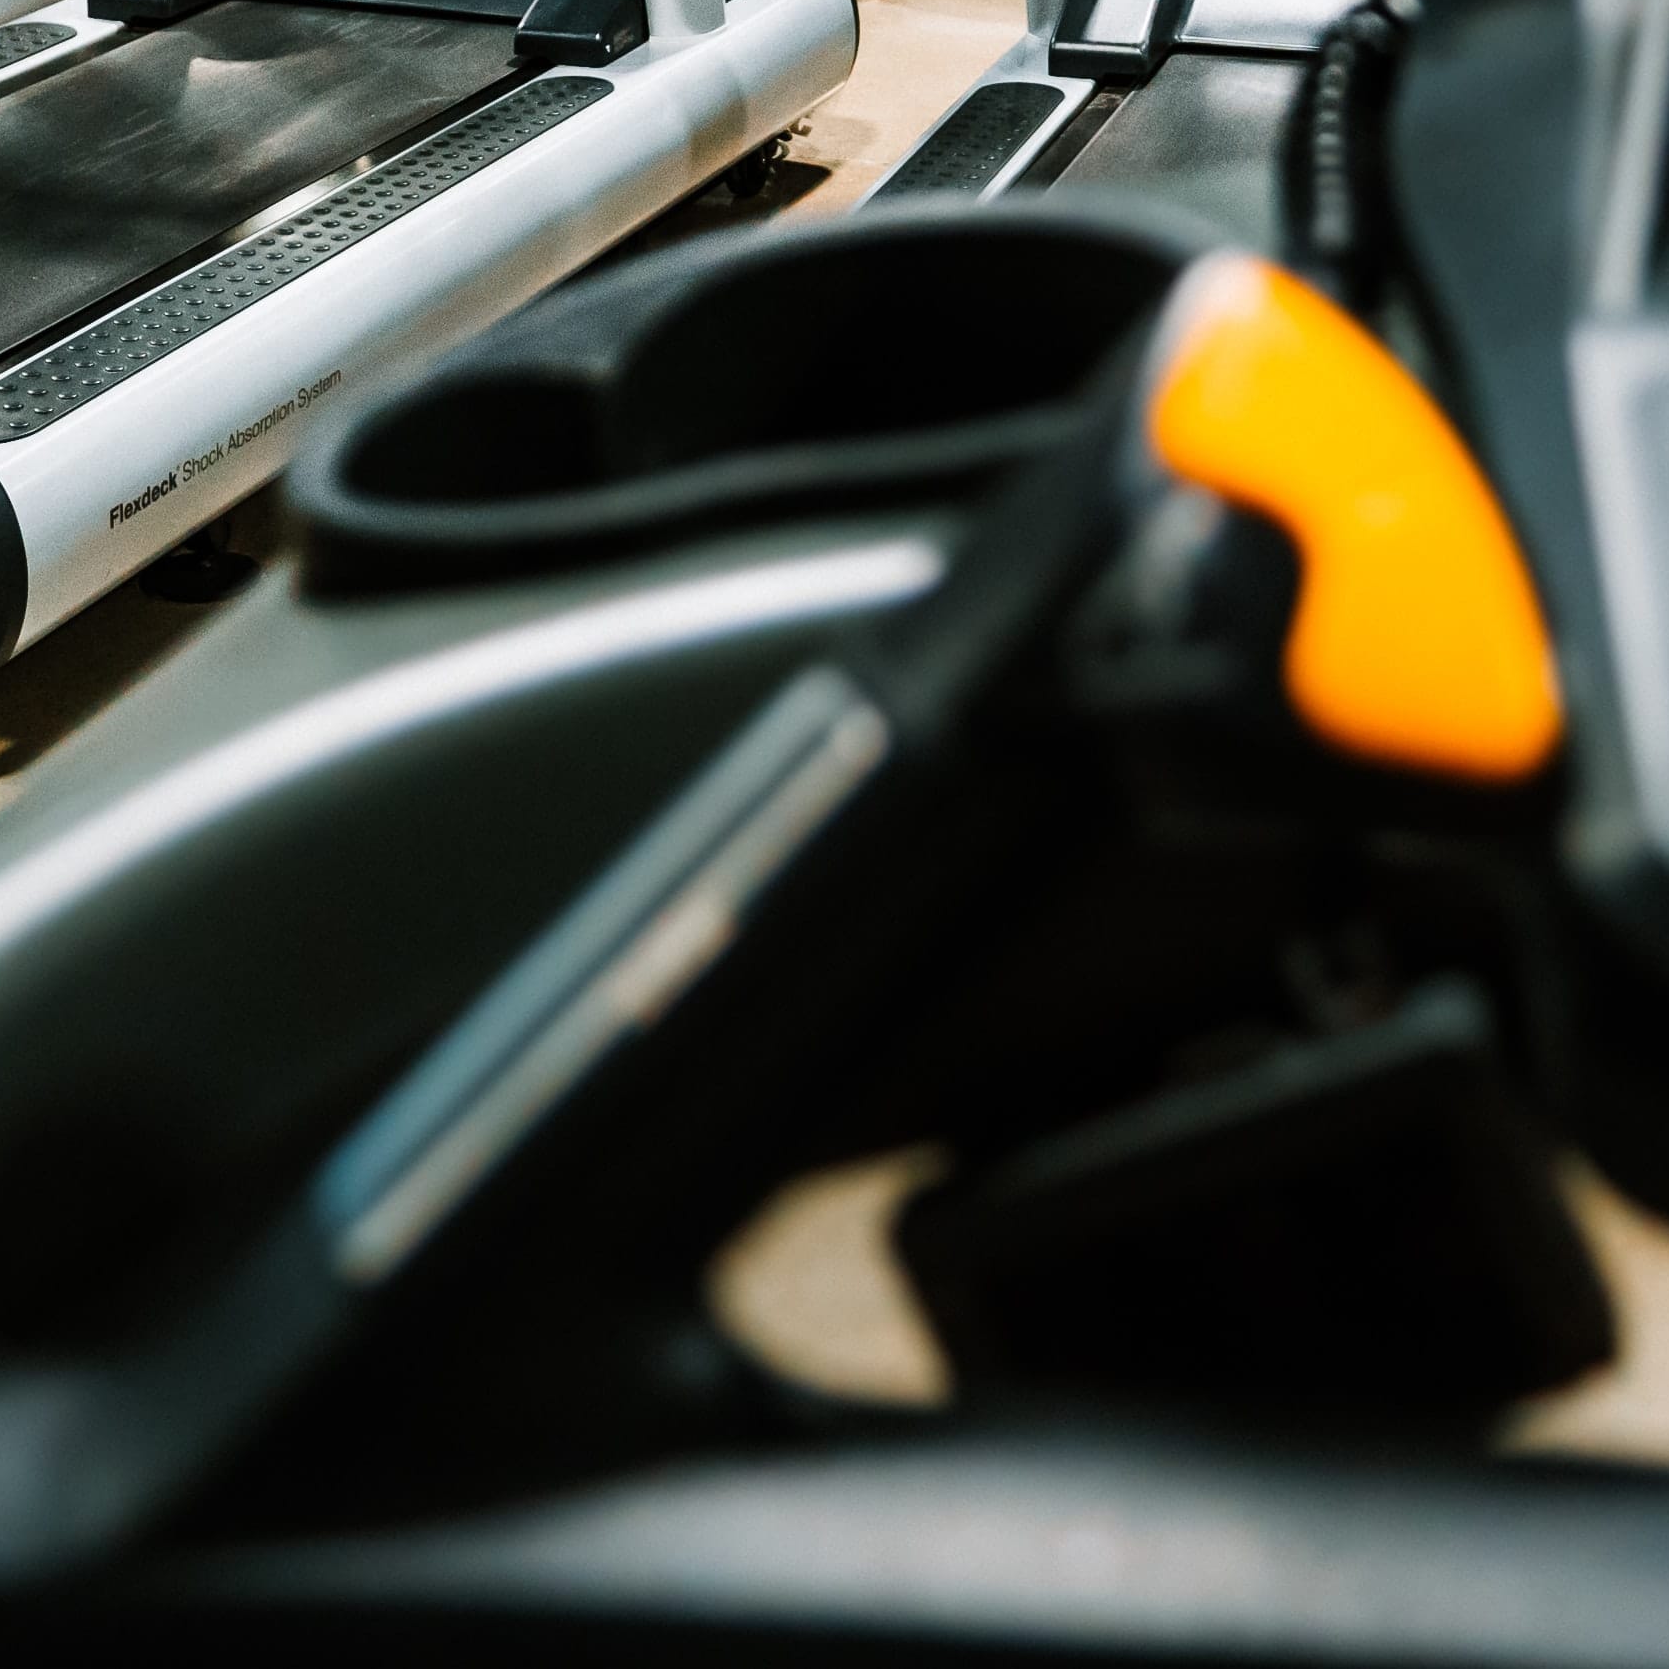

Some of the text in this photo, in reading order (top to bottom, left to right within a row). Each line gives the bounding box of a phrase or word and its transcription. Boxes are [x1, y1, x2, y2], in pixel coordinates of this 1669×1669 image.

[109, 369, 342, 530] Flexdeck Shock Absorption System
